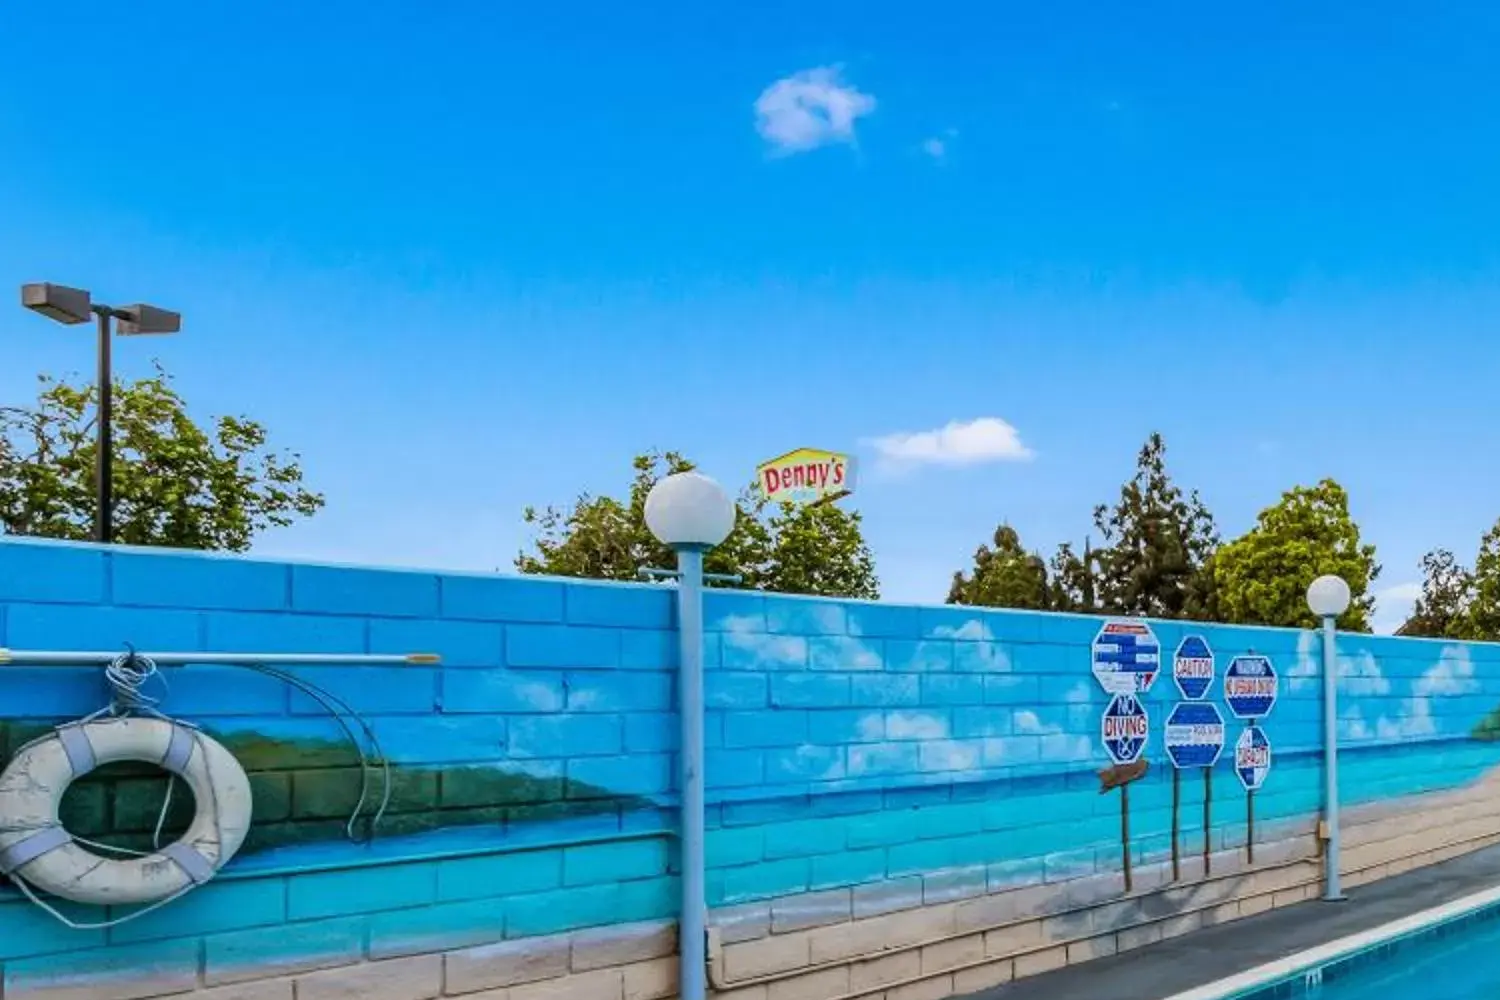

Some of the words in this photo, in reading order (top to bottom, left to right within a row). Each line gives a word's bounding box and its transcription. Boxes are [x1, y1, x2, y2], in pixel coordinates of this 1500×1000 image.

[764, 457, 843, 494] Denny's
[1117, 696, 1136, 715] NO
[1104, 715, 1146, 737] DIVING
